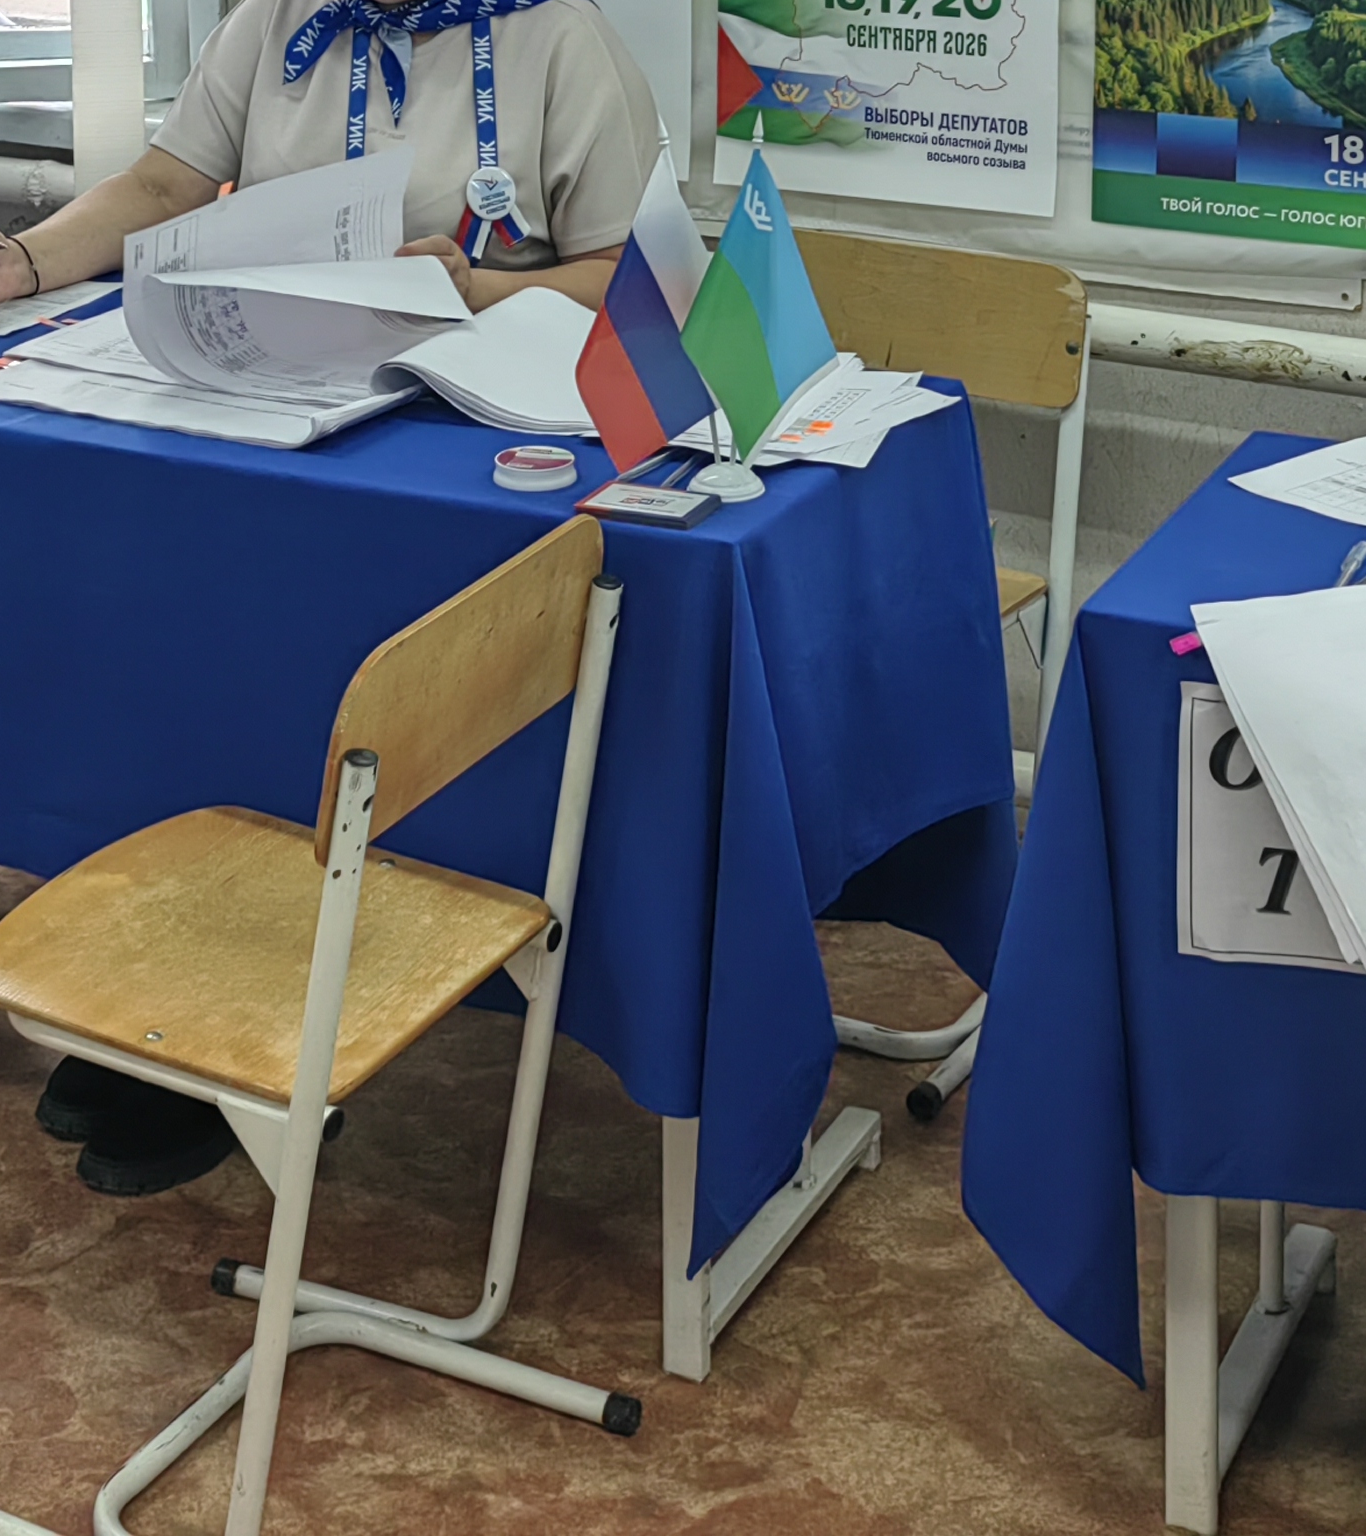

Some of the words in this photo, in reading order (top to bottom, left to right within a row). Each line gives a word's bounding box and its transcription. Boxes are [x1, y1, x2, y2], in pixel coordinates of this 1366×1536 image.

[293, 18, 325, 58] УИК
[474, 34, 490, 70] УИК
[846, 23, 937, 54] СЕНТЯБРЯ
[943, 31, 988, 57] 2026
[351, 55, 367, 92] УИК
[478, 87, 494, 122] УИК
[864, 106, 934, 128] ВЫБОРЫ
[938, 113, 1029, 136] ДЕПУТАТОВ
[348, 113, 364, 149] УИК
[864, 127, 928, 145] Тюменской
[931, 134, 991, 151] областной
[993, 139, 1028, 155] Думы
[480, 140, 497, 167] ИК
[926, 151, 980, 167] восьмого
[982, 155, 1026, 170] созыва
[1160, 196, 1203, 215] ТВОЙ
[1206, 201, 1260, 220] ГОЛОС
[1281, 206, 1336, 227] ГОЛОС
